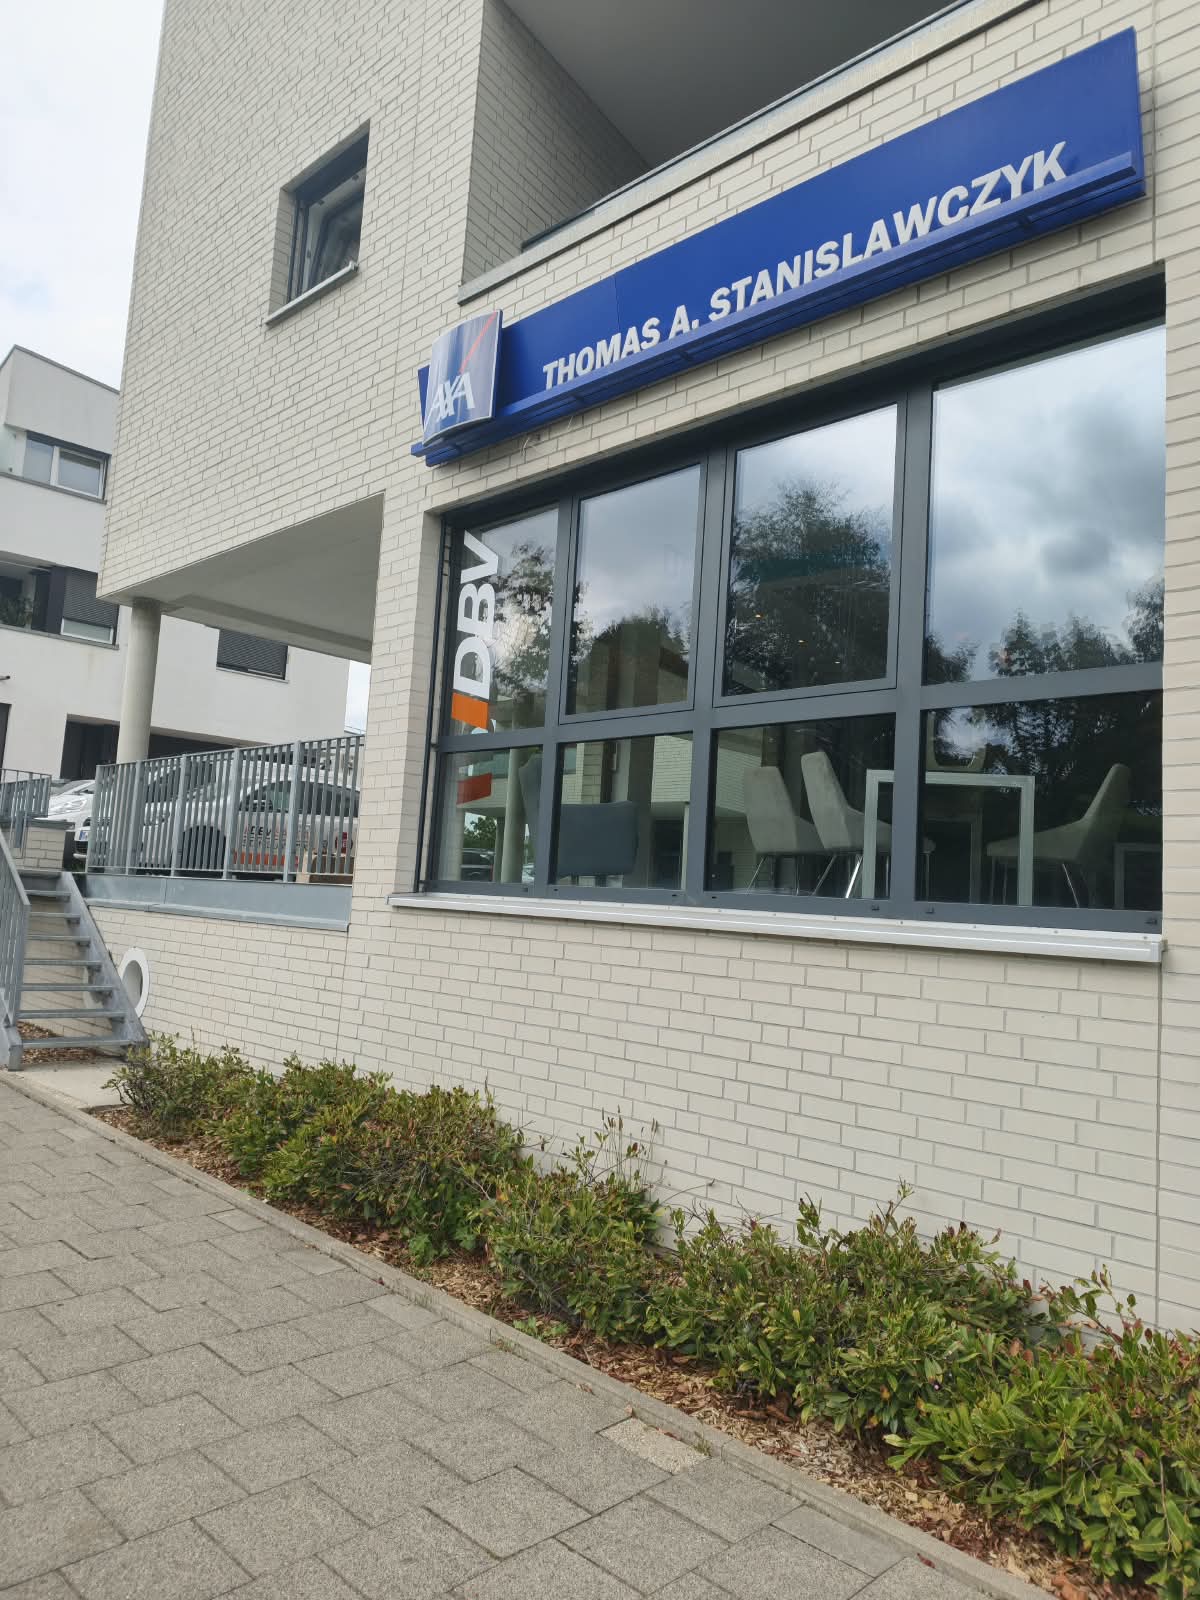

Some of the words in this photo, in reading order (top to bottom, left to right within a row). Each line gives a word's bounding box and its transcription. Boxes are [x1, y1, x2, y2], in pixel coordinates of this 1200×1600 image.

[543, 317, 661, 390] THOMAS
[668, 304, 700, 340] A.
[709, 141, 1067, 322] STANISLAWCZYK
[424, 371, 476, 430] AXA
[453, 530, 499, 700] DBV
